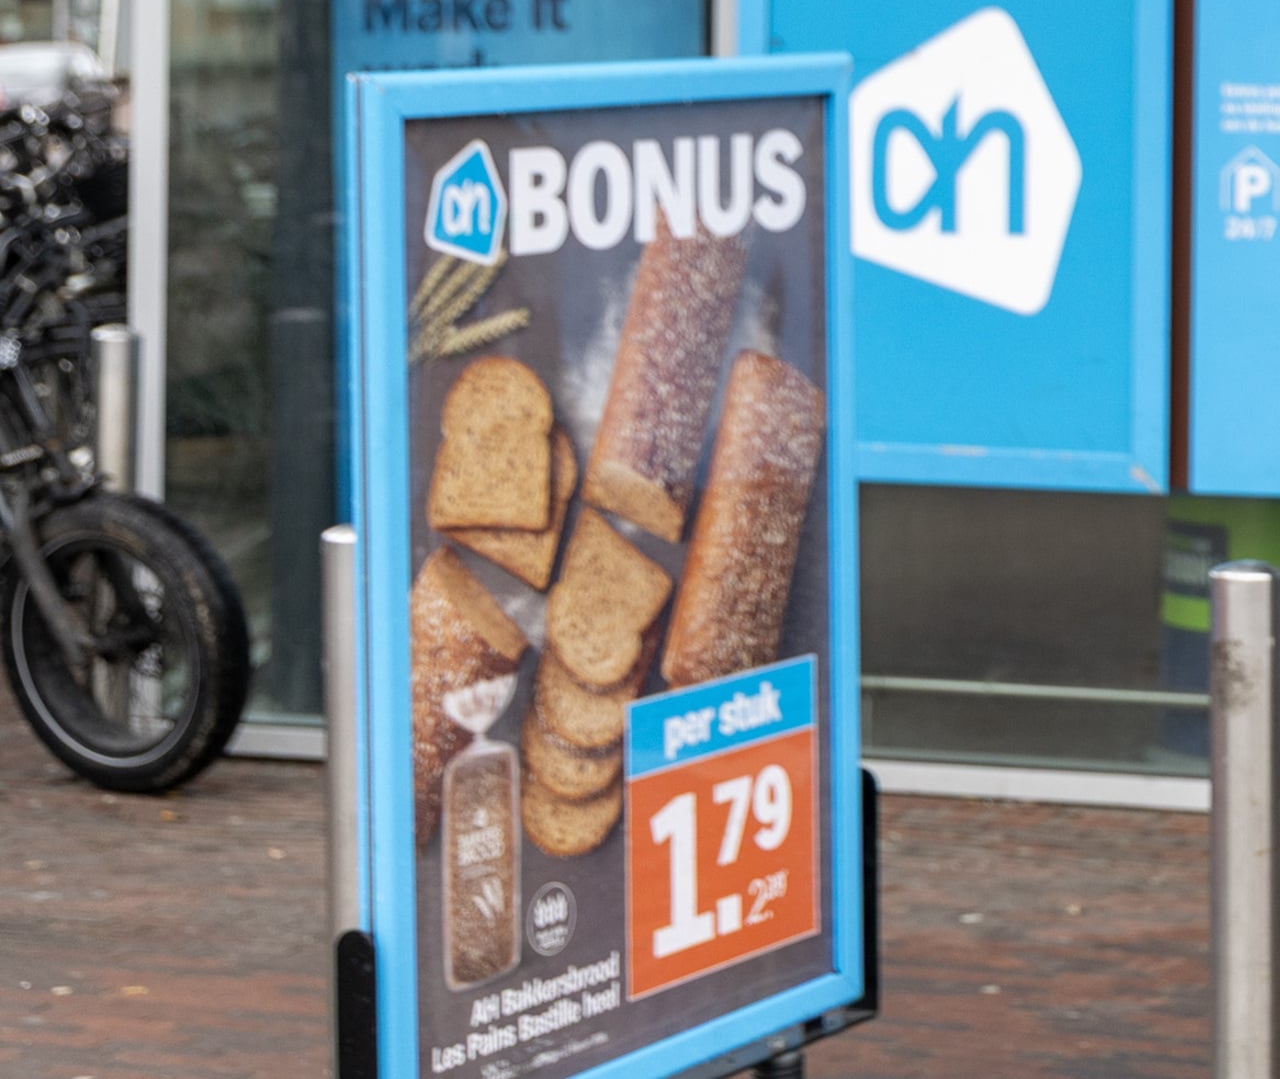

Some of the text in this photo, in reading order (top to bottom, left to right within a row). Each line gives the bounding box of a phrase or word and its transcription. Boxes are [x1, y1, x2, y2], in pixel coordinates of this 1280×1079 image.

[508, 128, 807, 257] BONUS
[1233, 163, 1271, 212] P
[663, 680, 783, 761] per stuk
[431, 1043, 467, 1074] Les
[467, 1024, 518, 1061] Pains
[518, 997, 583, 1042] Bastille
[582, 980, 621, 1018] heel
[470, 950, 621, 1028] AH Bakkersbrood
